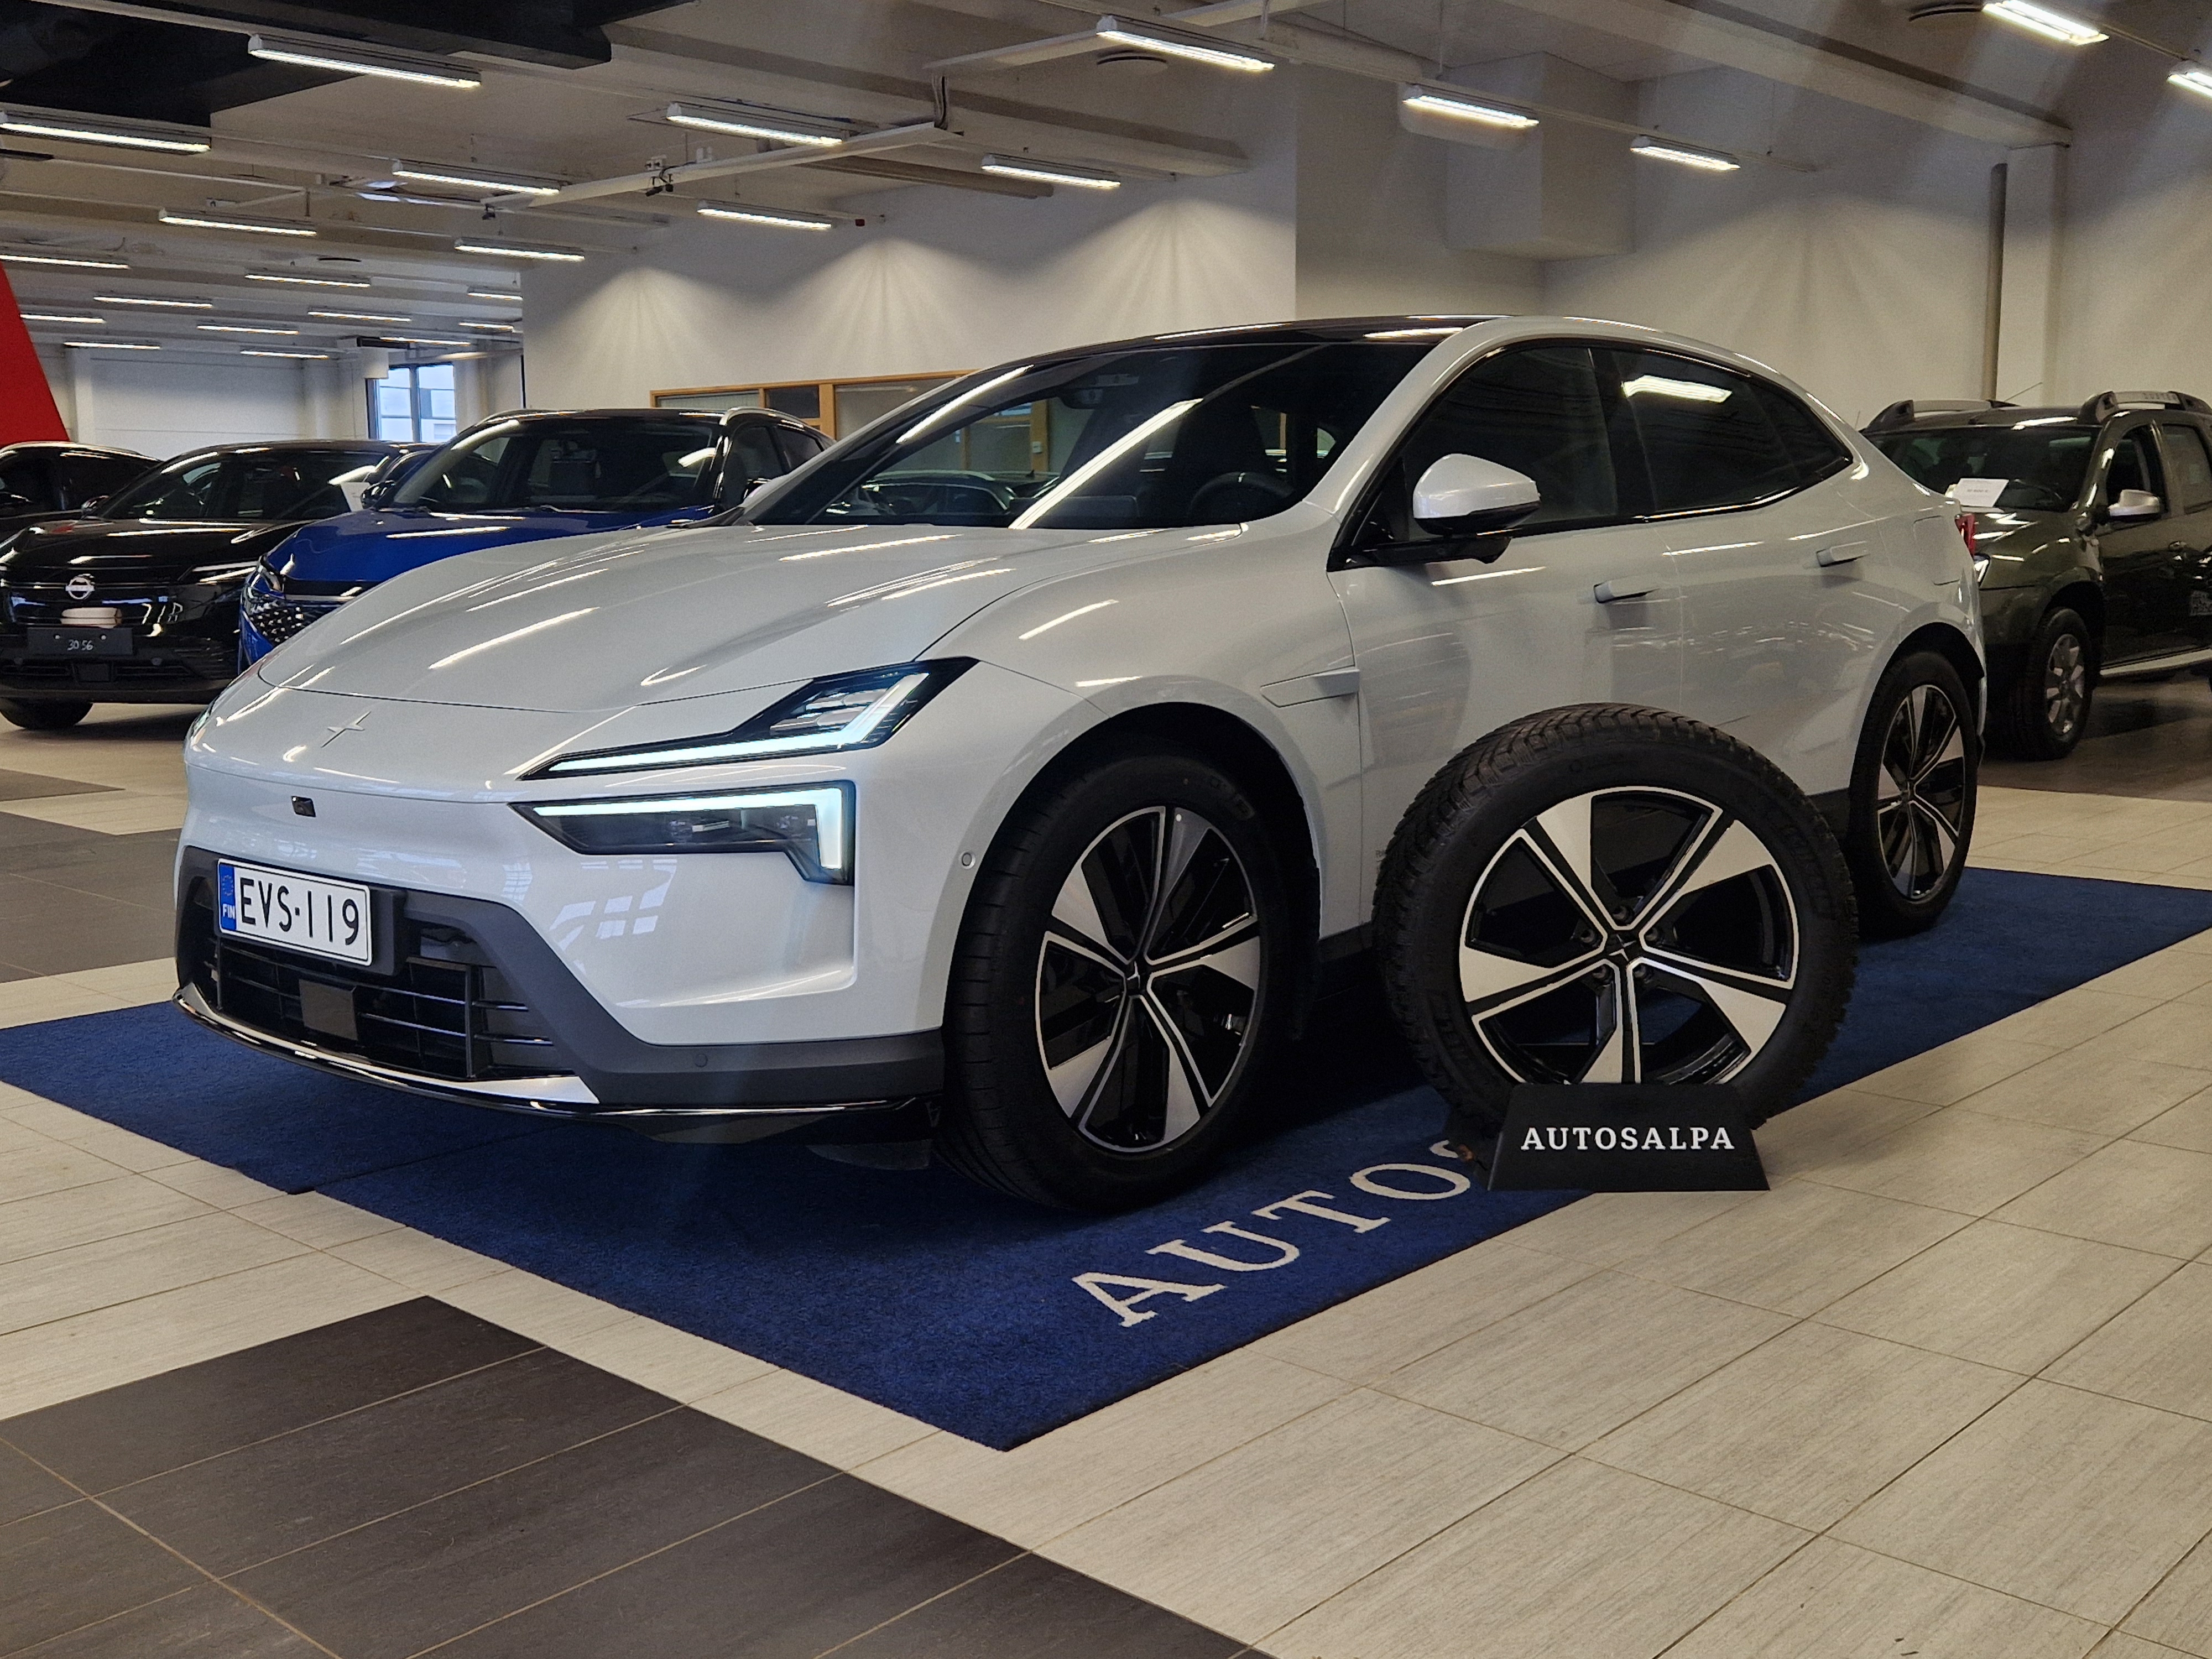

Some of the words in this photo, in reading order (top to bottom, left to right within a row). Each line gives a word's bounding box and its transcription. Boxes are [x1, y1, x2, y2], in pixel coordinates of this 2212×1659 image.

[222, 903, 236, 920] FIN
[240, 877, 359, 946] EVS-119
[1520, 1127, 1735, 1150] AUTOSALPA
